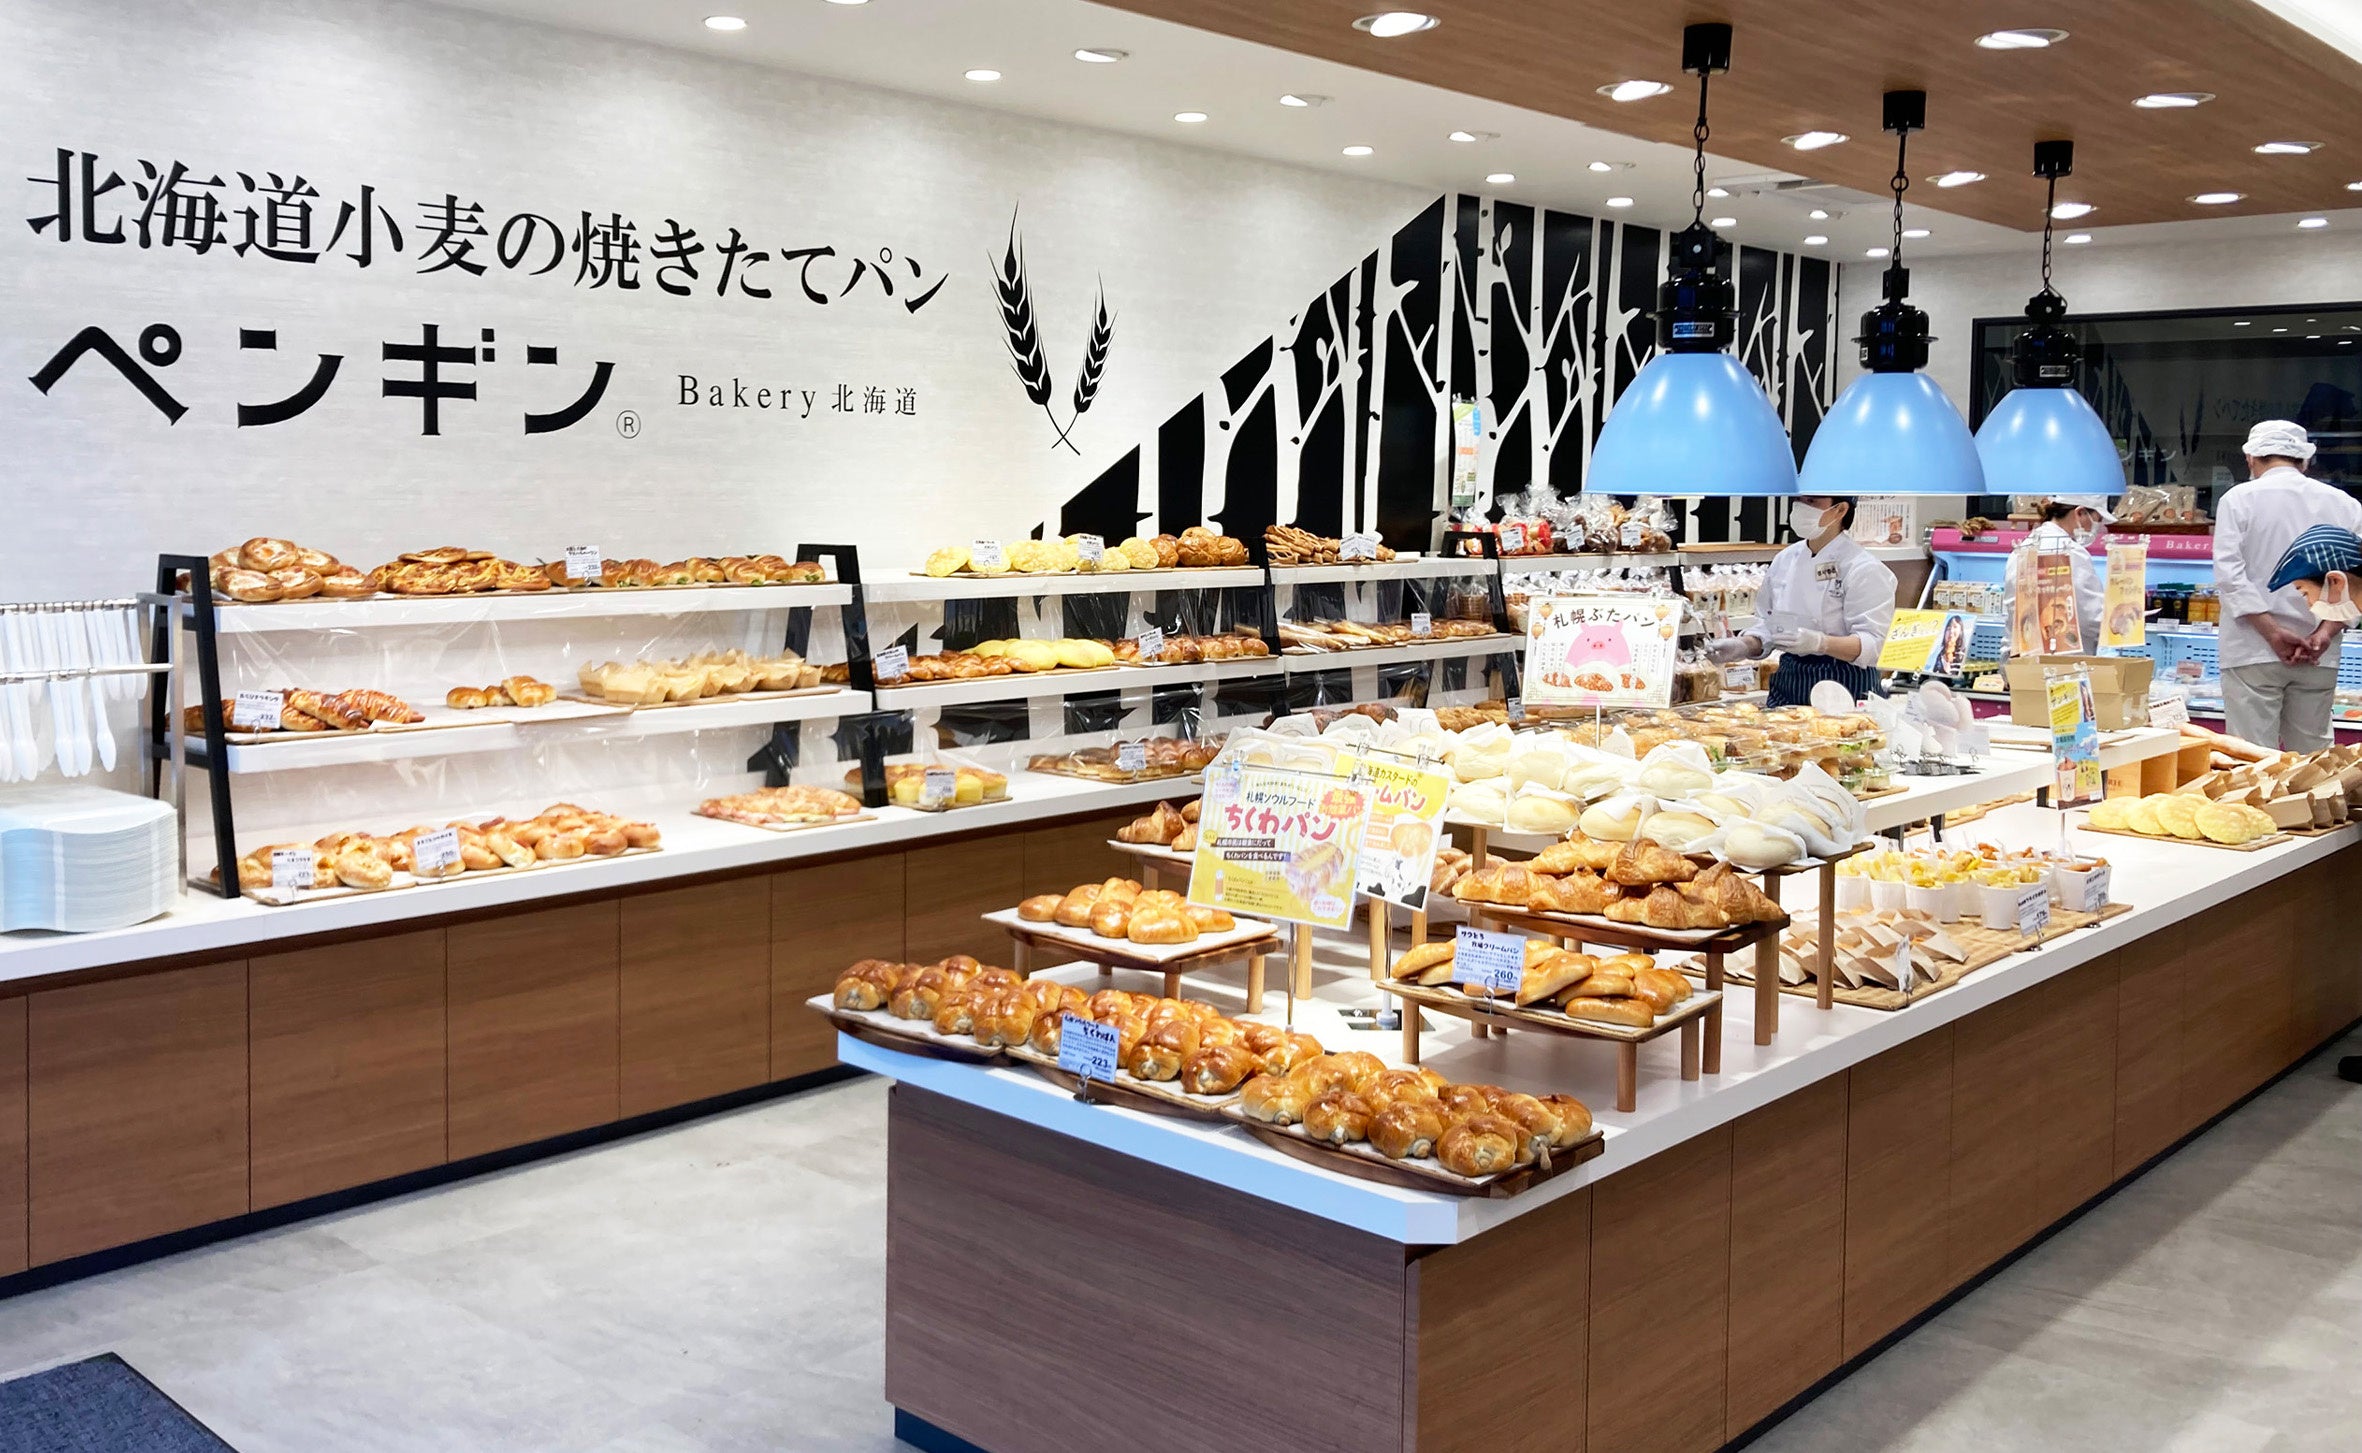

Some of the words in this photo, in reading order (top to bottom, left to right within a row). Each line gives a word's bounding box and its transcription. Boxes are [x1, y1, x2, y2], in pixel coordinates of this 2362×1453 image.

[27, 148, 949, 314] 北海道小麦の焼きたてパン
[28, 323, 616, 436] ペンギン
[678, 375, 816, 418] Bakery
[831, 383, 917, 416] 北海道
[1224, 803, 1337, 841] ちくわパン
[1246, 792, 1317, 809] 札幌ソウルフード
